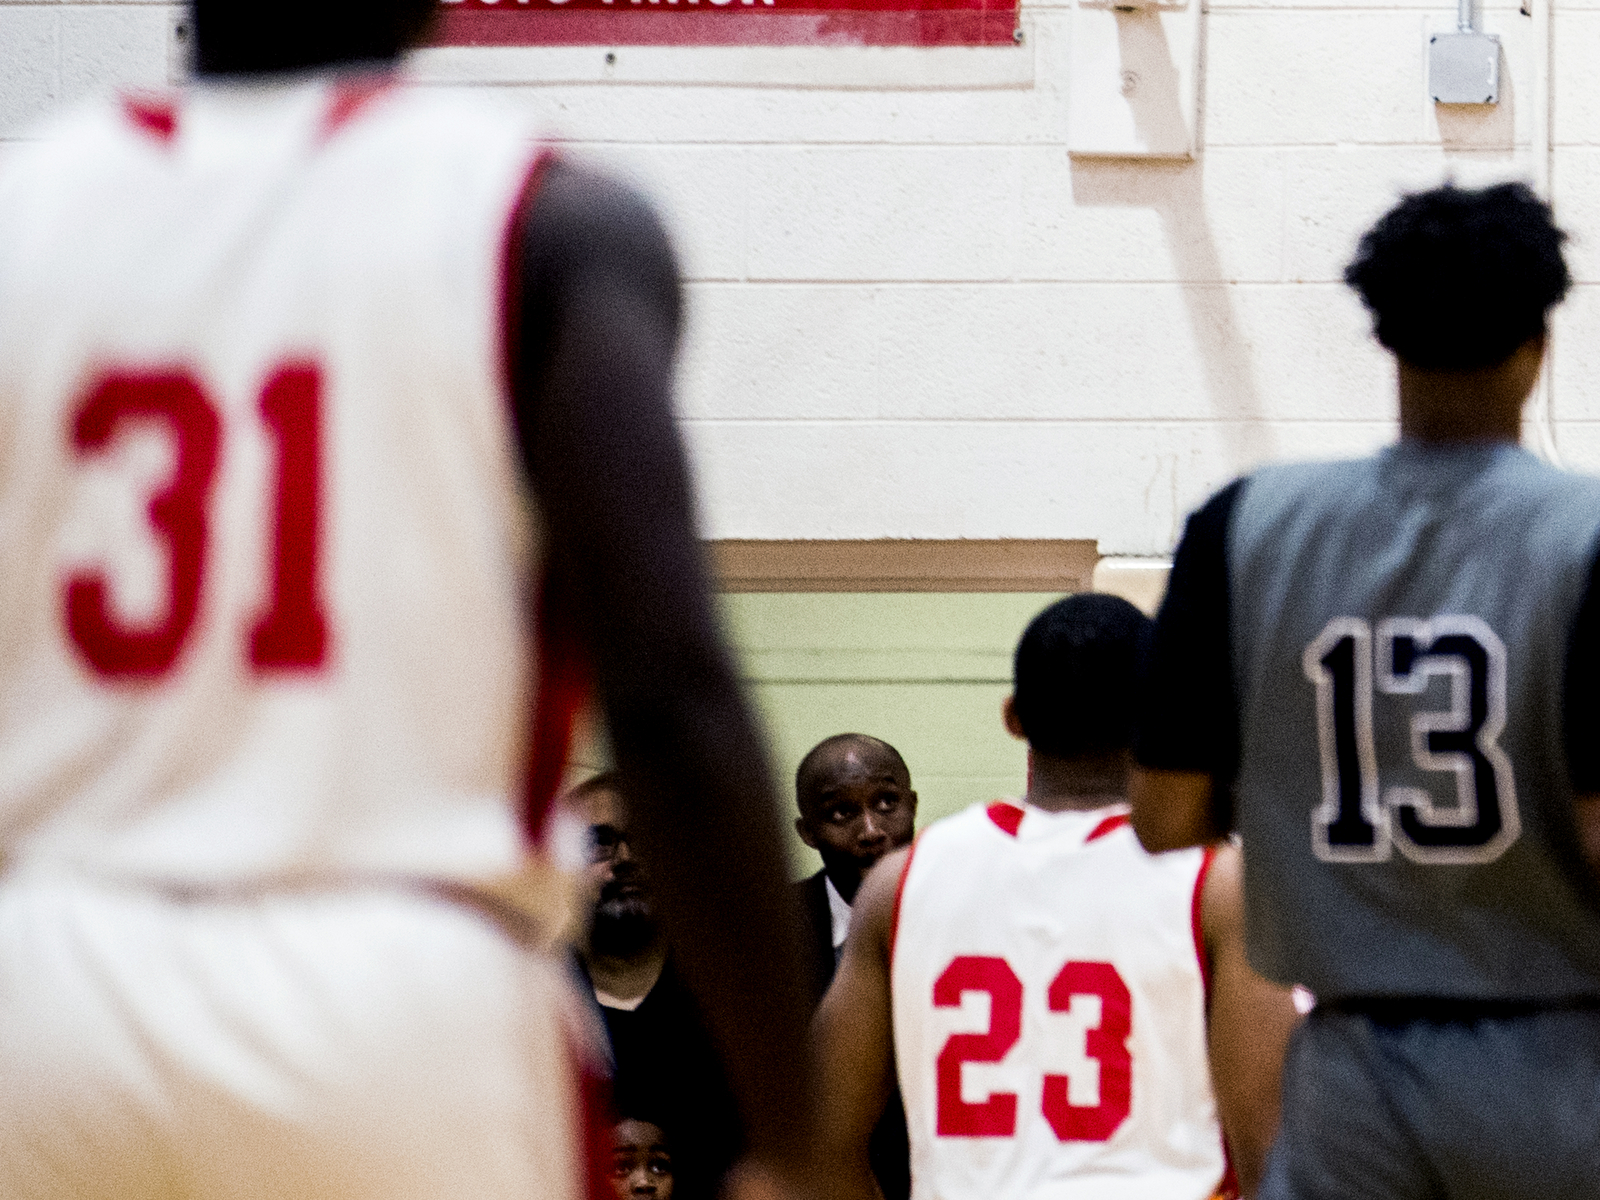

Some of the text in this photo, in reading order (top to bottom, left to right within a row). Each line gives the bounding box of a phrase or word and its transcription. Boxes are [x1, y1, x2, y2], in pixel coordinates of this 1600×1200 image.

[64, 361, 331, 683] 31
[1303, 614, 1522, 864] 13
[932, 955, 1133, 1143] 23
